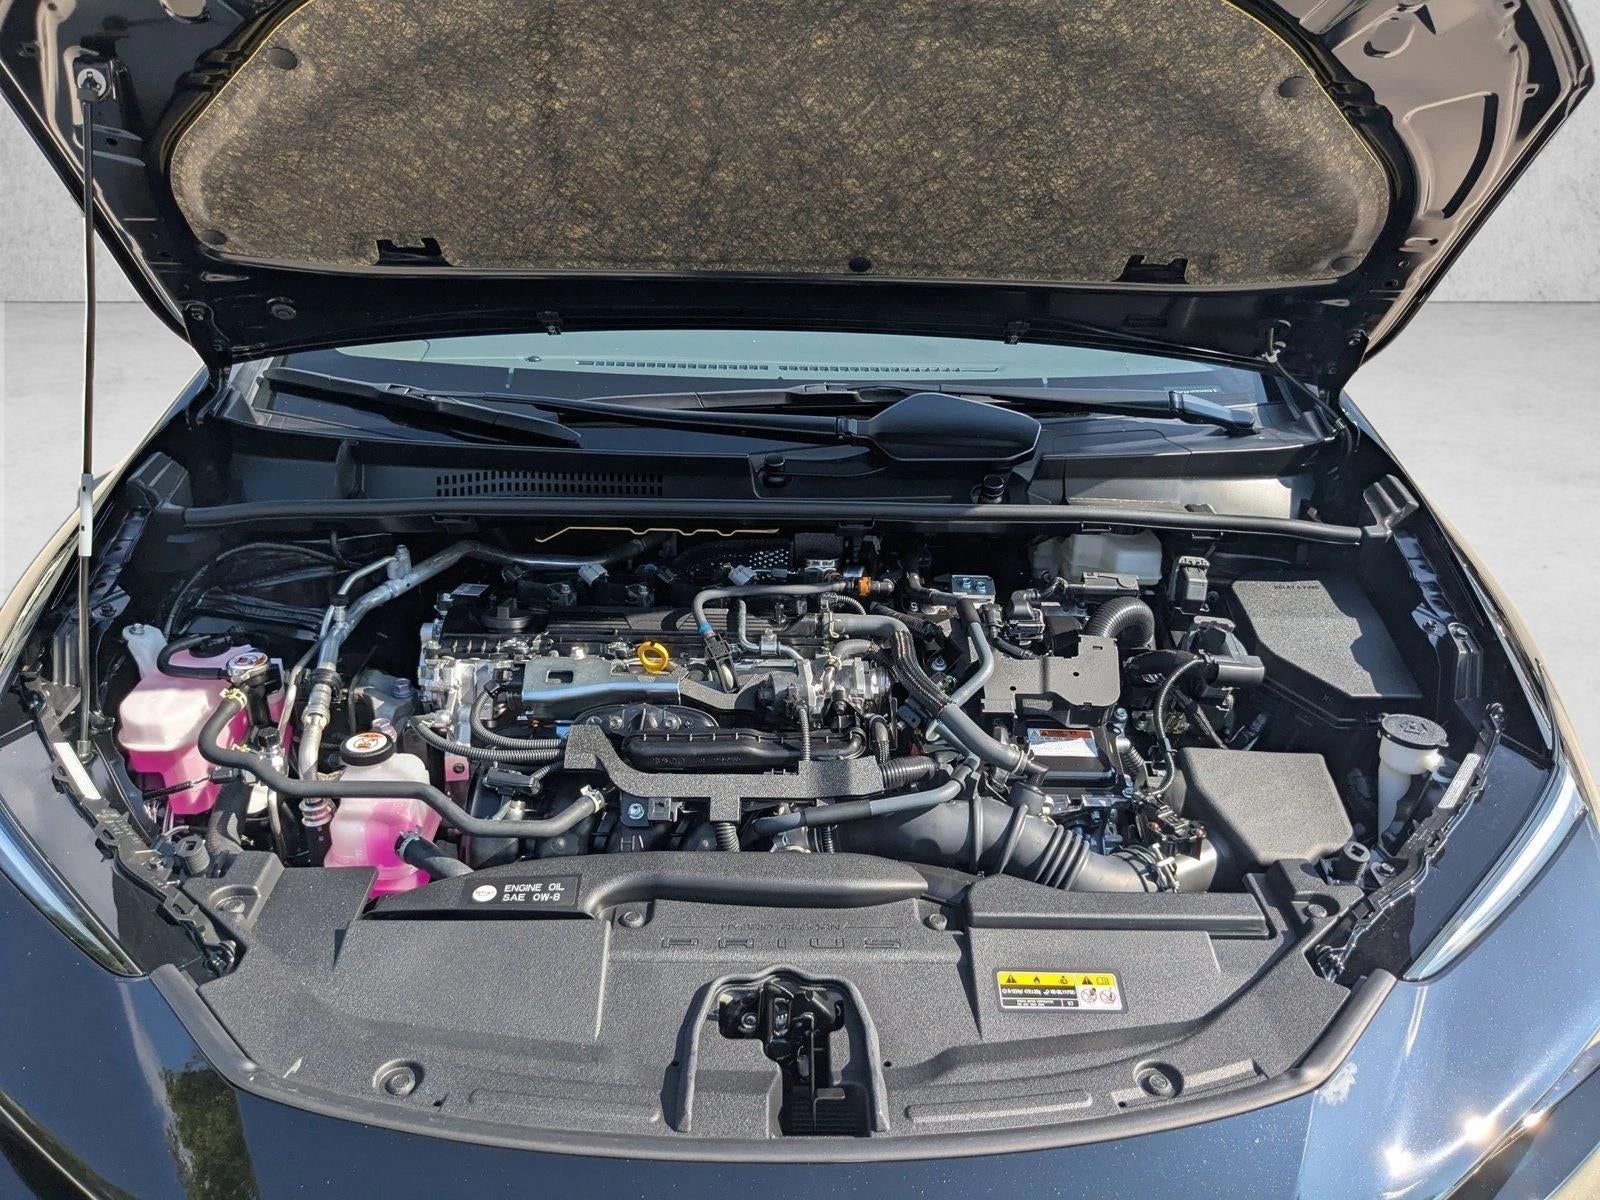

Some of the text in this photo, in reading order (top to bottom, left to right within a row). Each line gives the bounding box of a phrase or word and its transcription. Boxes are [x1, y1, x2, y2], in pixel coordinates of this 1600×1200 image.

[504, 882, 565, 892] ENGINE OIL
[502, 893, 526, 901] SAE
[661, 937, 900, 949] PRIUS
